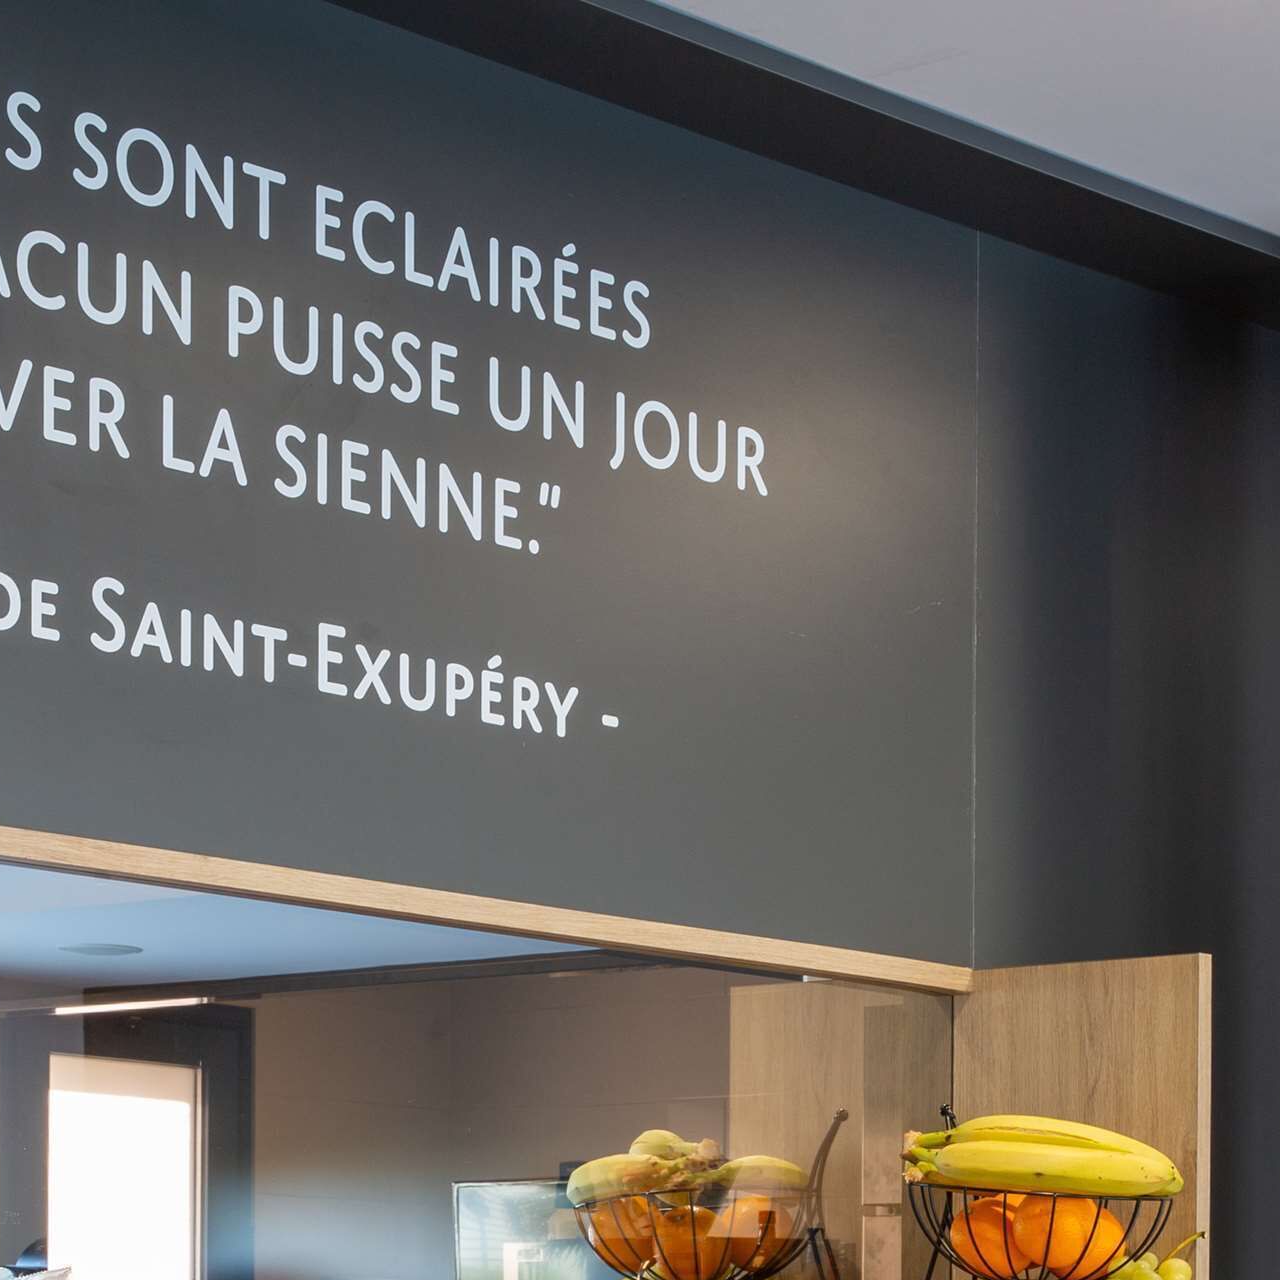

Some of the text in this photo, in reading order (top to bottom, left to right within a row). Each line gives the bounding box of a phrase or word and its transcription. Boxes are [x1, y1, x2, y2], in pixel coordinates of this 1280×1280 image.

[72, 111, 287, 241] SONT
[315, 184, 651, 349] ECLAIRÉES
[162, 394, 248, 487] LA
[227, 284, 460, 416] PUISSE
[489, 356, 585, 449] UN
[609, 391, 769, 497] JOUR
